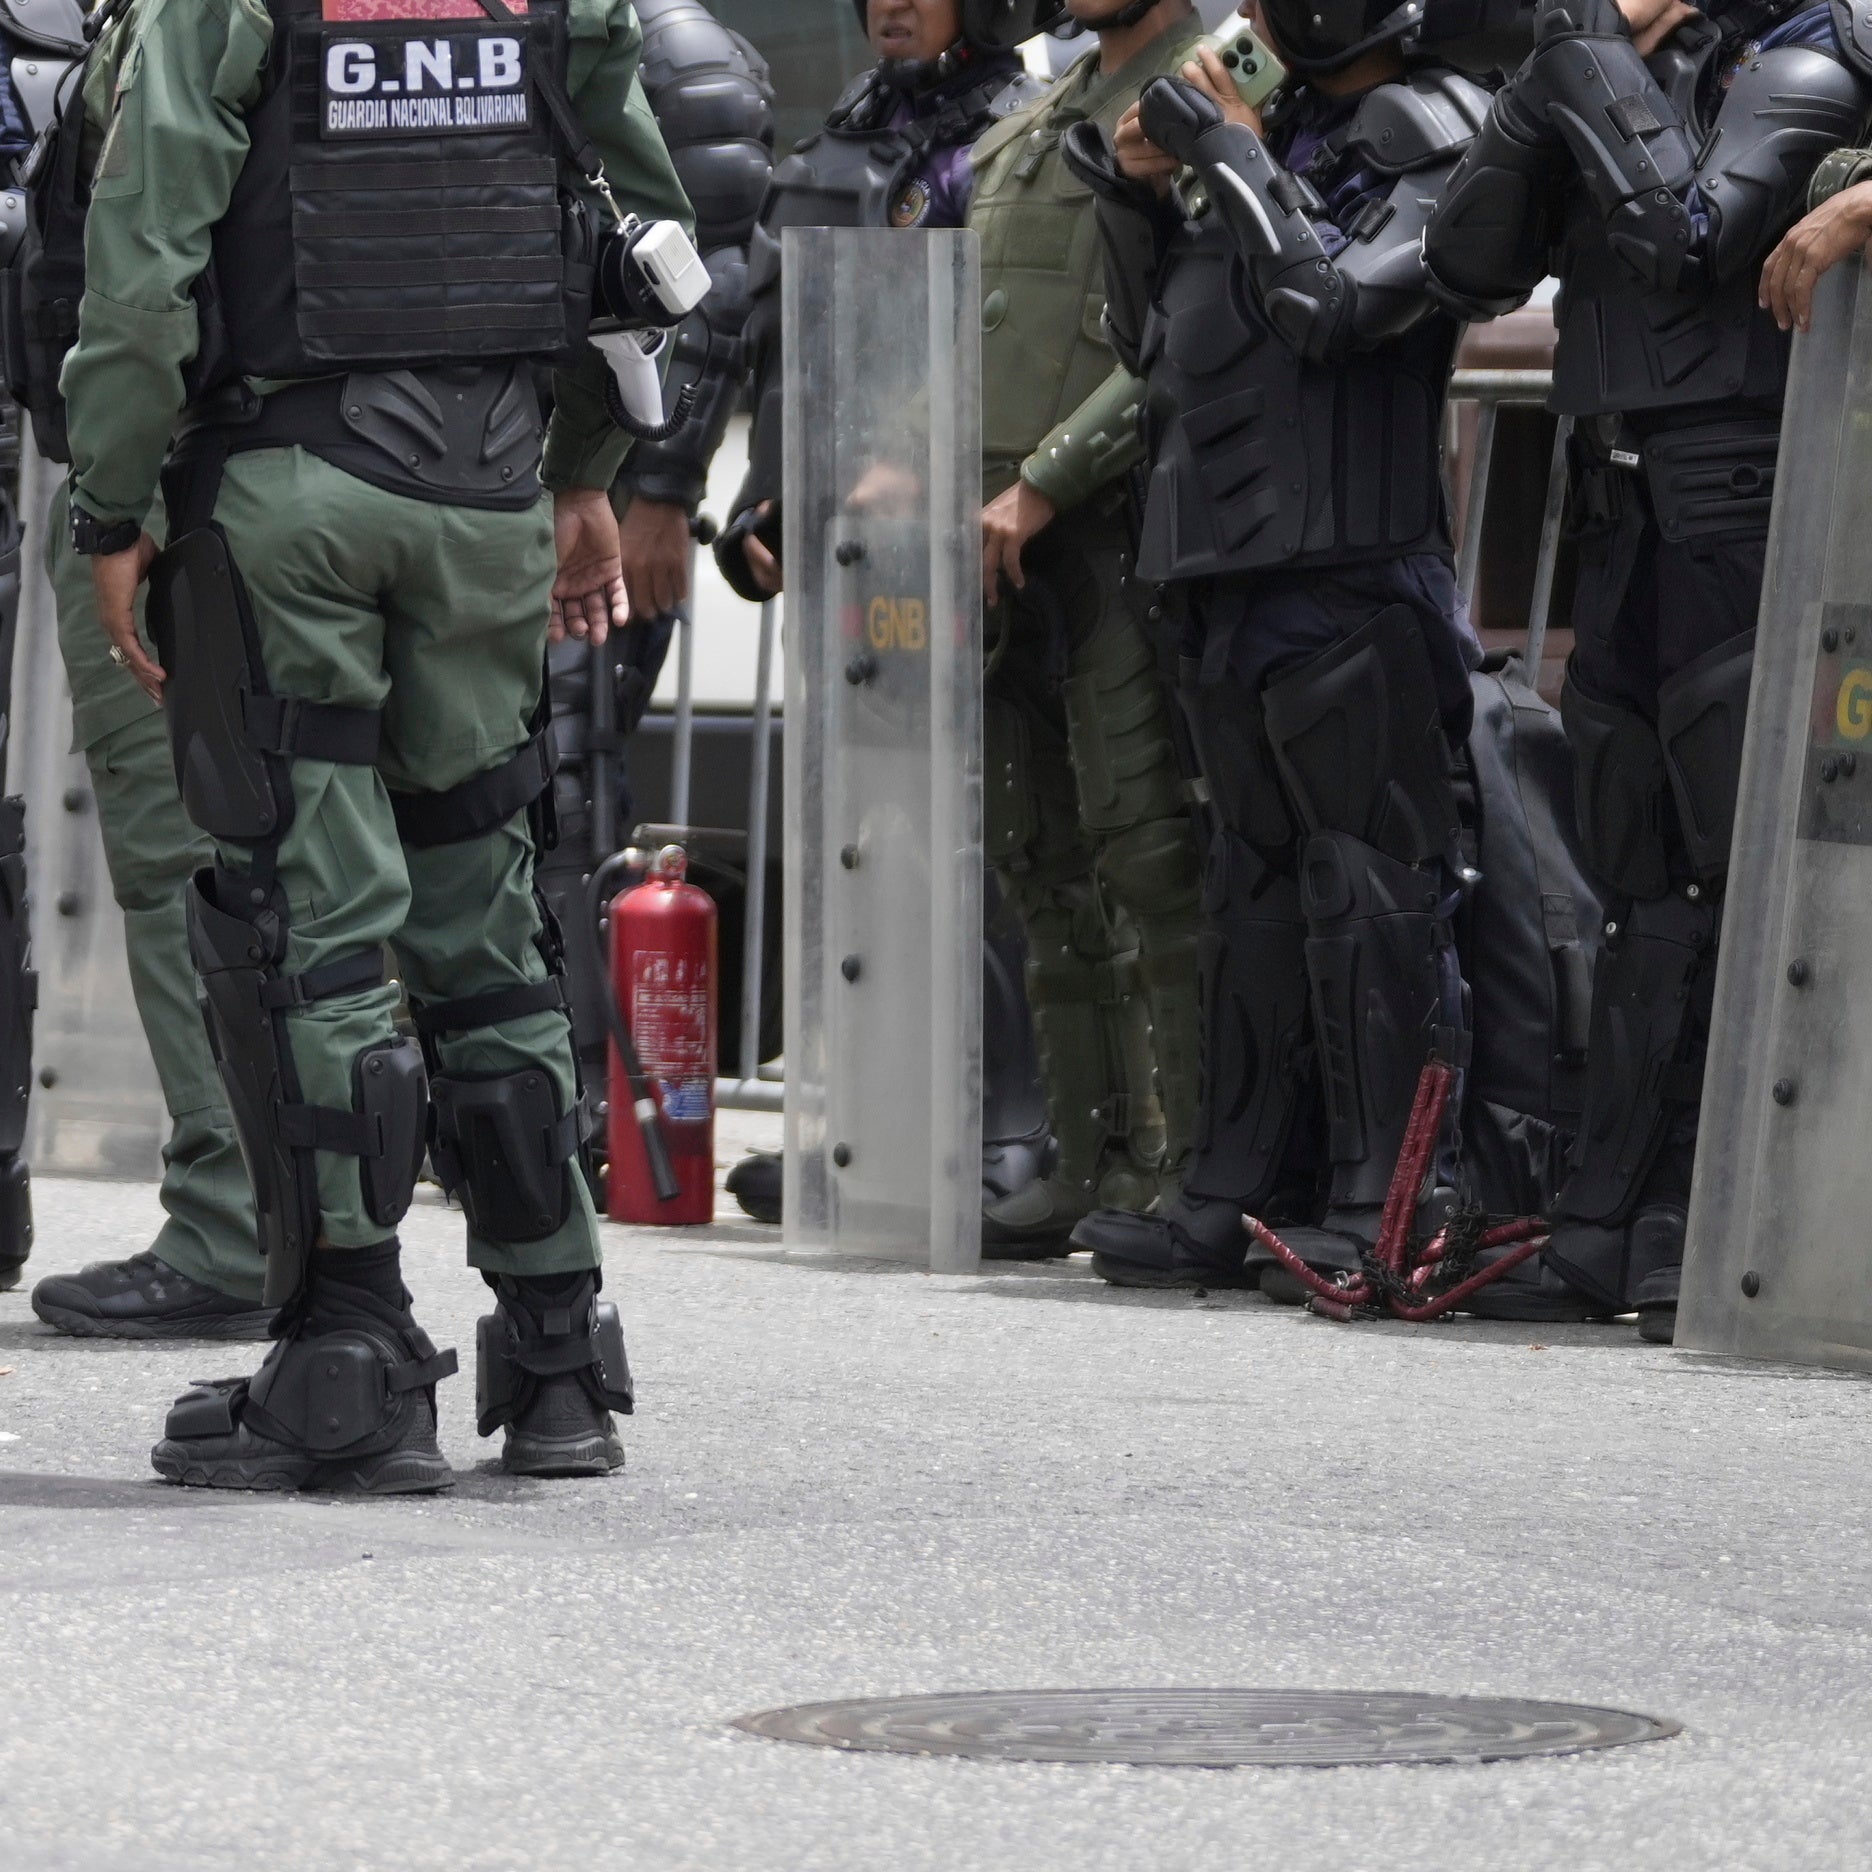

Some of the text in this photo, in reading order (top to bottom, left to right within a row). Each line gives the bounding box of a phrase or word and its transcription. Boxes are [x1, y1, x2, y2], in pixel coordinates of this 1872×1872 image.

[326, 37, 522, 94] G.N.B
[327, 93, 527, 129] GUARDIA NACIONAL BOLIVARIANA
[869, 595, 926, 650] GNB
